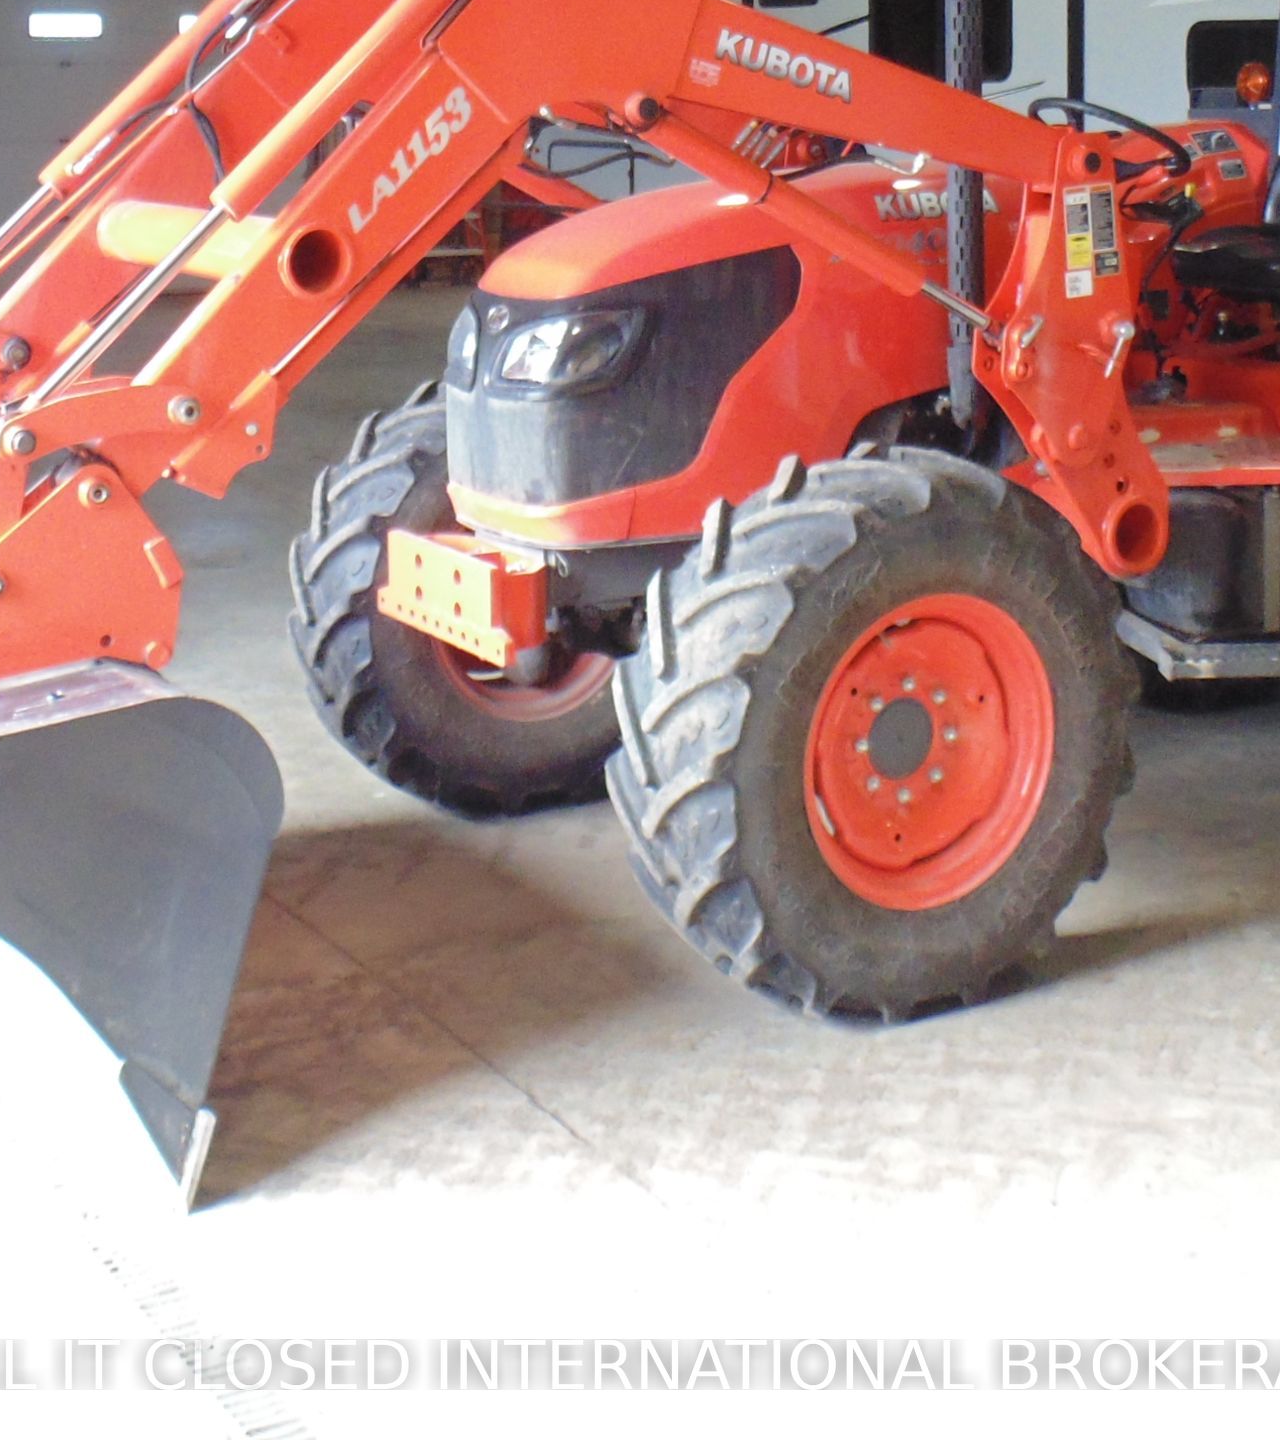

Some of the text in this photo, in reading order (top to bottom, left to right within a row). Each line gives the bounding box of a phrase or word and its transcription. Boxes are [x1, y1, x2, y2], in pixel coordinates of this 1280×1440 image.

[716, 28, 852, 104] KUBOTA
[348, 85, 472, 234] LA1153
[874, 189, 1000, 221] KUBA
